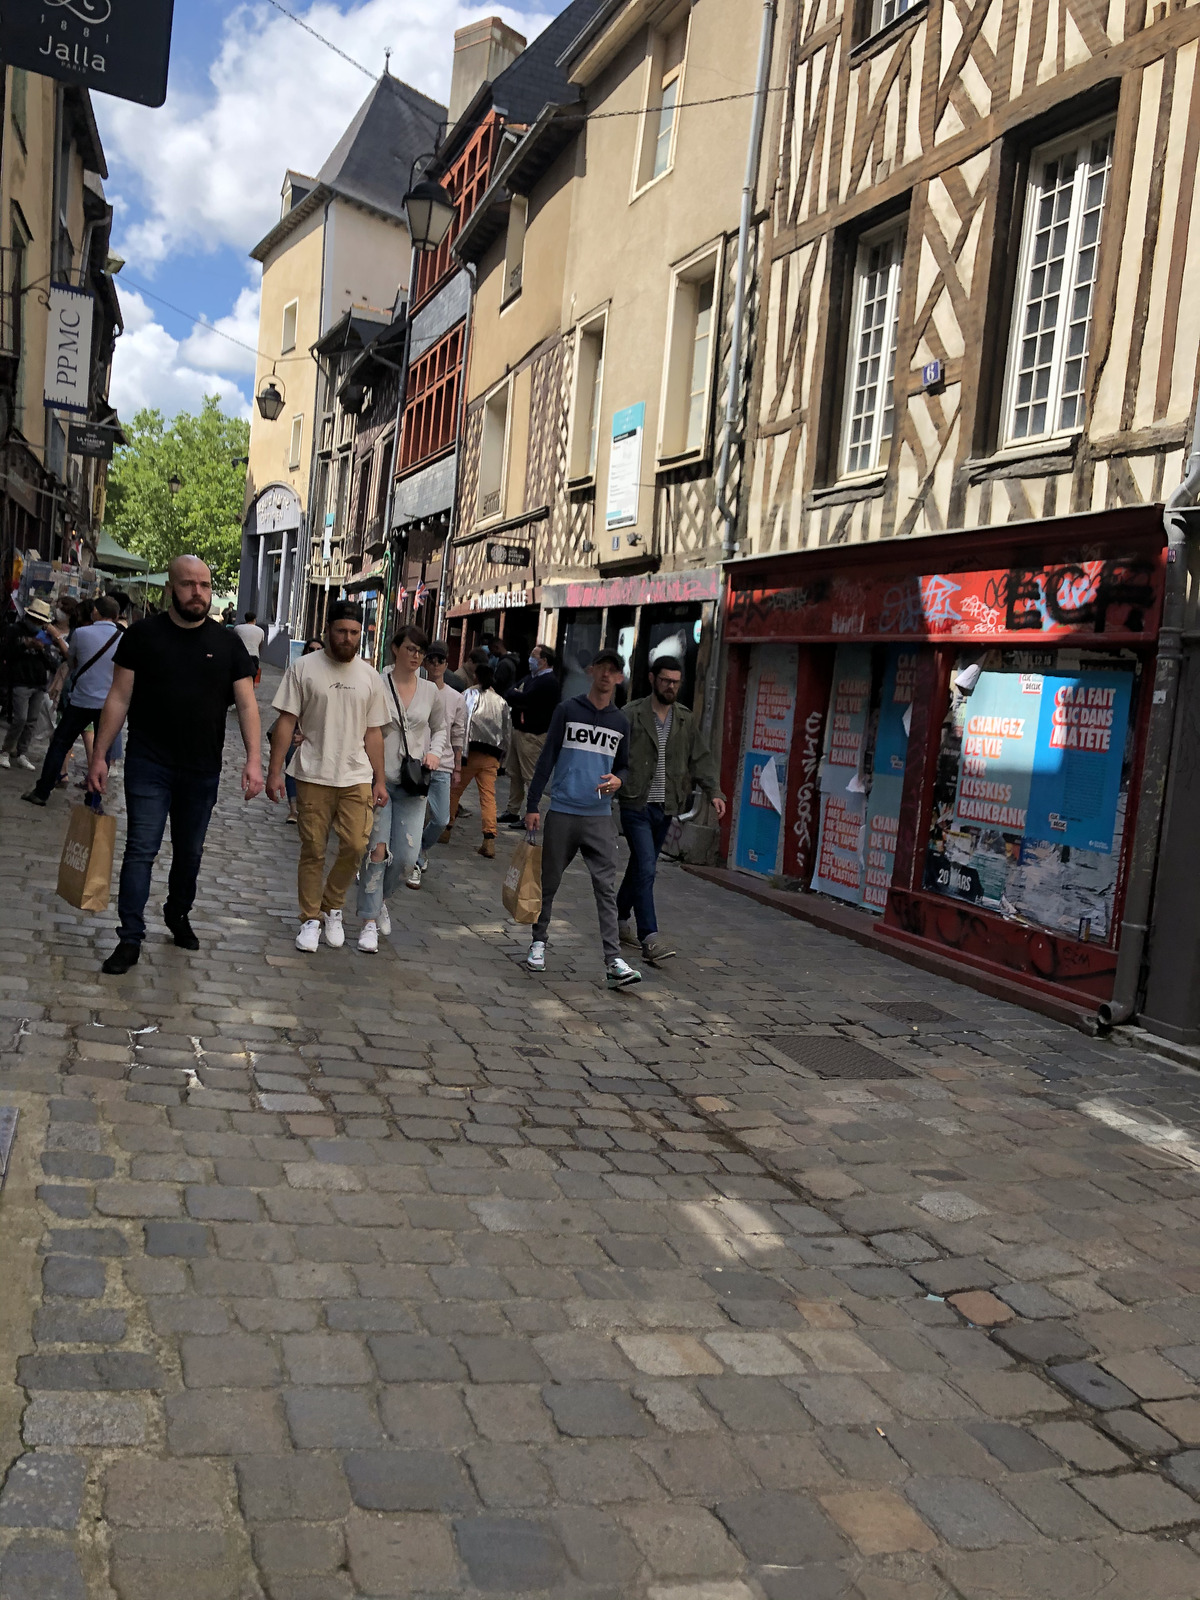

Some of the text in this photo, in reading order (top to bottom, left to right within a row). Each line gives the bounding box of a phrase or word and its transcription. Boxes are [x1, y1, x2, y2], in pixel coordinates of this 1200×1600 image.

[39, 35, 105, 72] Jalla
[56, 309, 80, 387] PPMC
[926, 364, 935, 382] 6
[1075, 687, 1085, 705] A
[1086, 687, 1116, 708] FAIT
[833, 716, 851, 731] SUR
[968, 715, 1025, 738] CHANGEZ
[1052, 706, 1113, 729] CLIC DANS
[1050, 724, 1077, 749] MA
[965, 738, 981, 756] DE
[982, 739, 1003, 759] VIE
[962, 759, 986, 779] SUR
[960, 779, 1012, 804] KISSKISS
[957, 800, 1027, 830] BANKBANK
[869, 833, 882, 850] DE
[867, 851, 886, 869] SUR
[937, 868, 949, 885] 20
